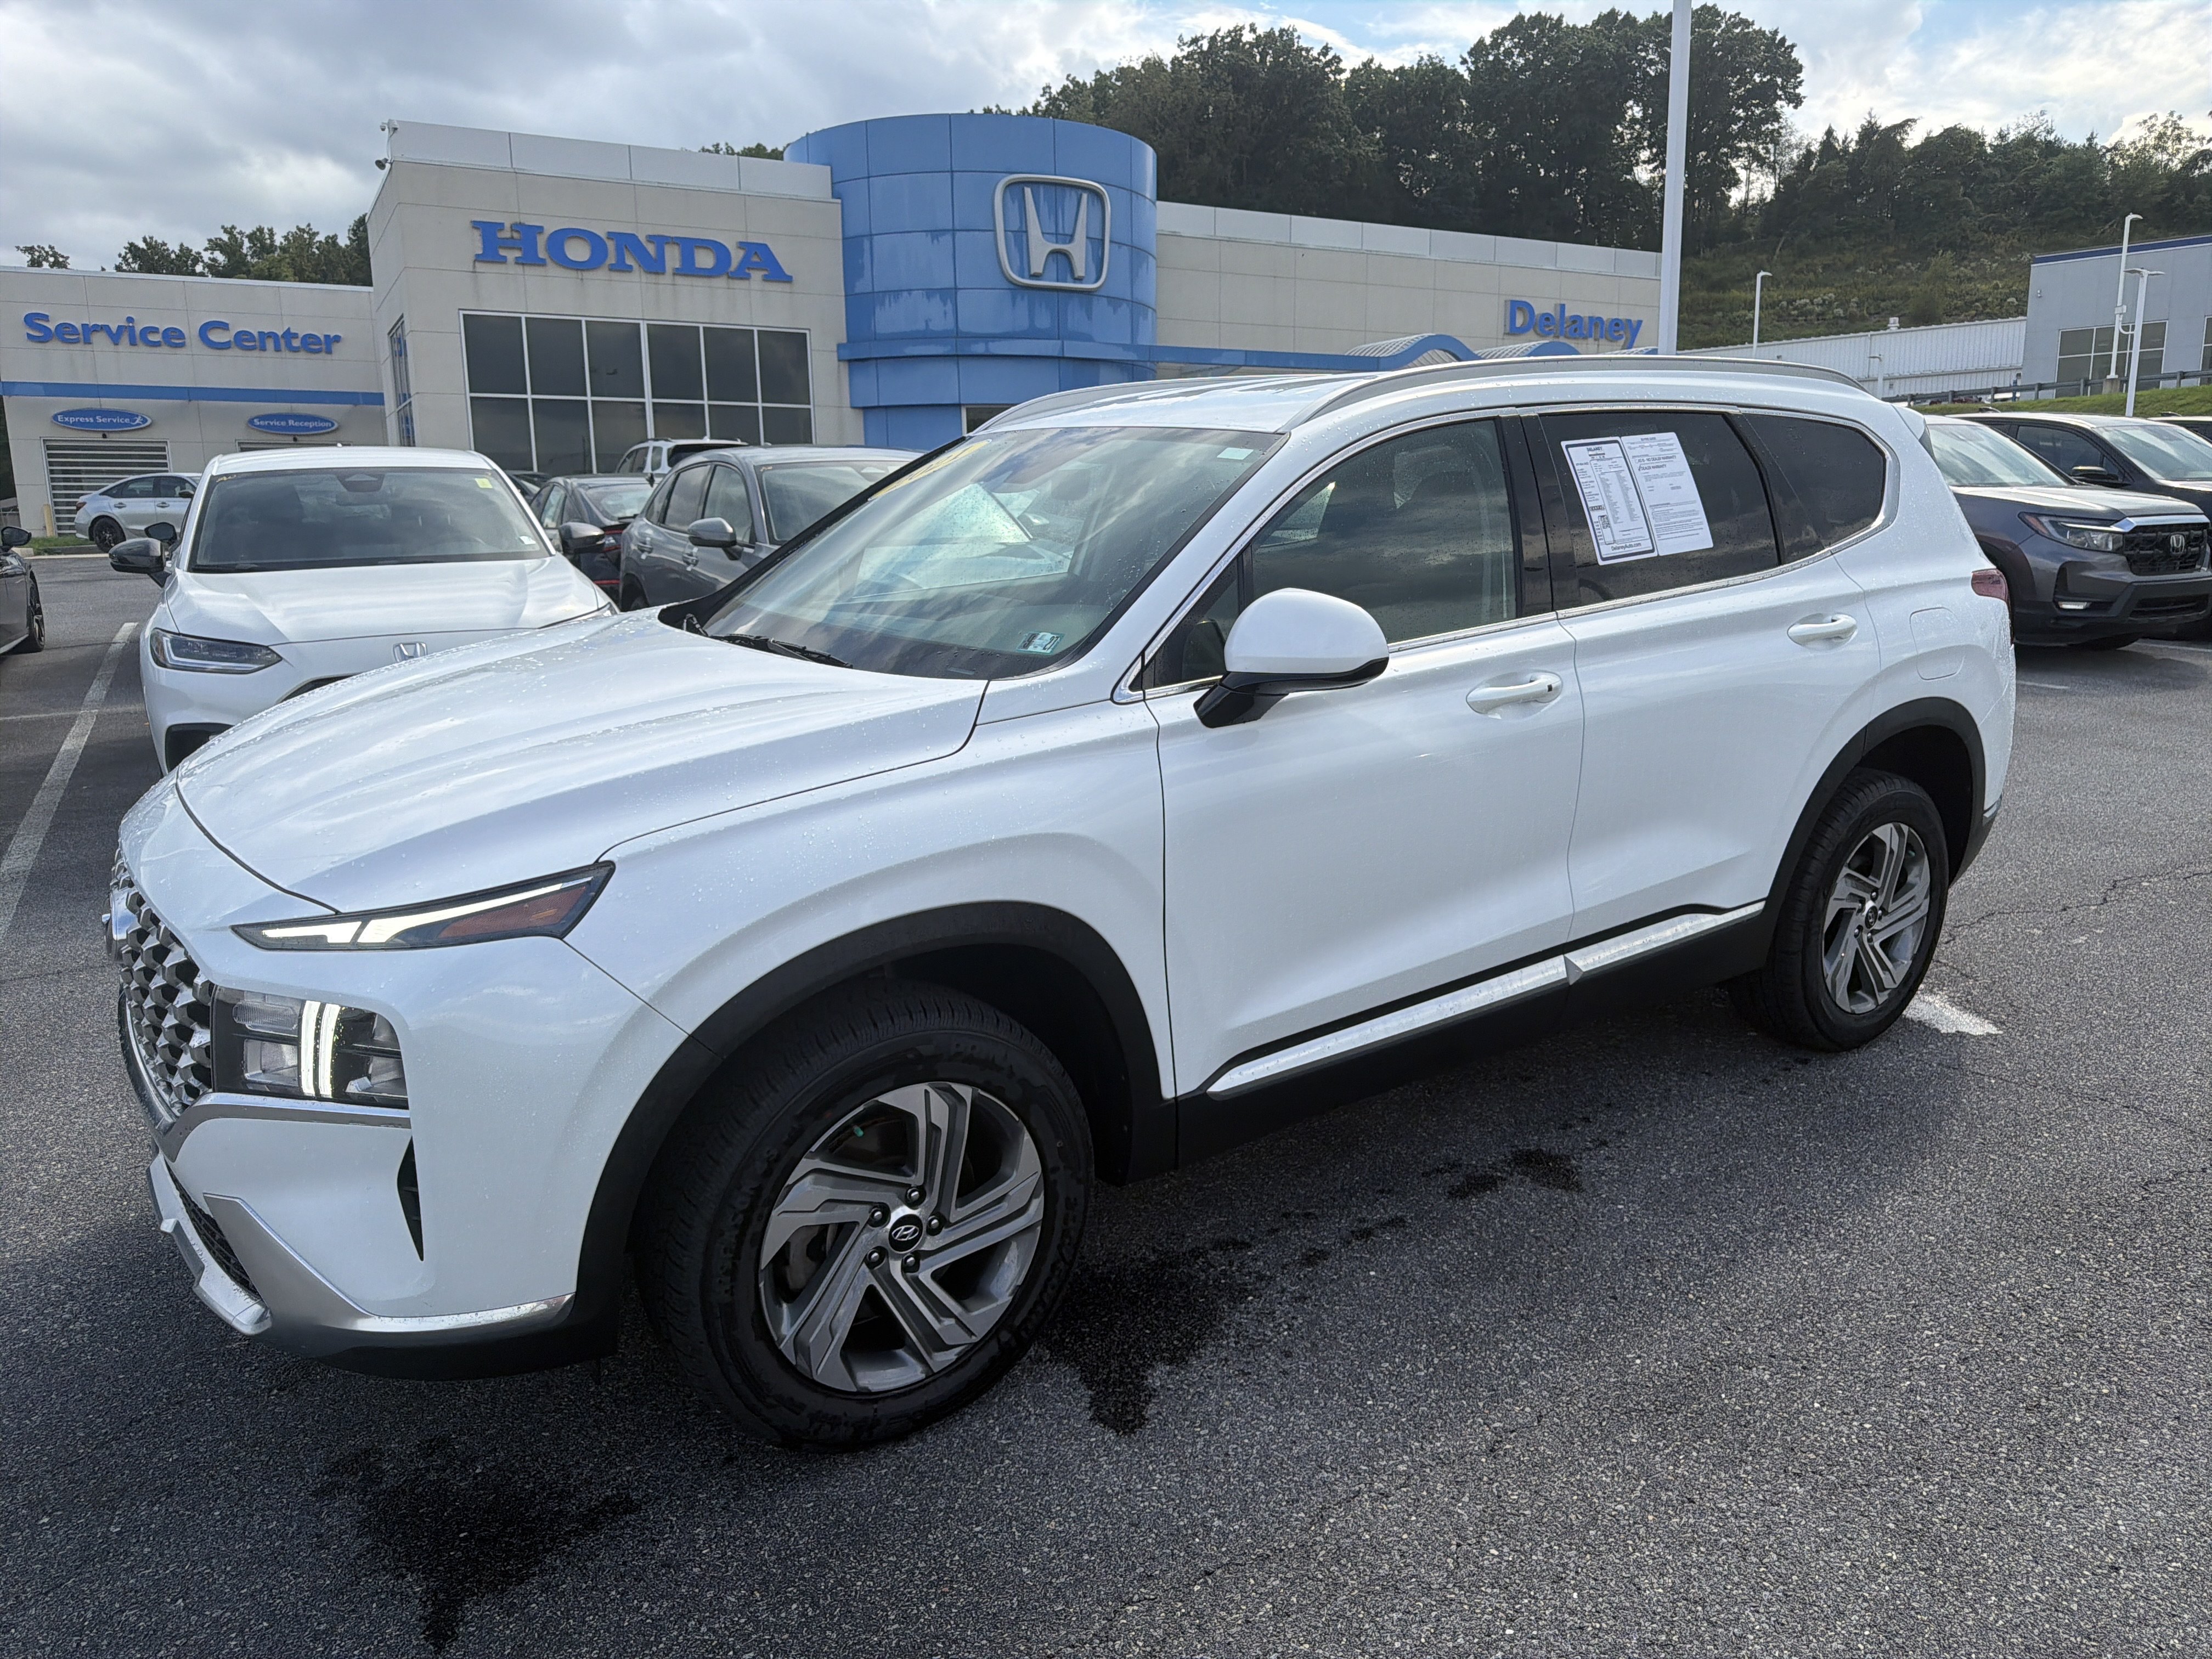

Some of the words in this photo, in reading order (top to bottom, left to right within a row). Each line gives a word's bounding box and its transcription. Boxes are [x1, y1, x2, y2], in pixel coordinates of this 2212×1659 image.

[472, 220, 793, 282] HONDA
[24, 312, 186, 348] Service
[198, 320, 342, 354] Center
[1506, 300, 1643, 349] Delaney
[57, 415, 94, 424] Express
[95, 415, 131, 424] Service
[253, 418, 287, 426] Service
[288, 419, 331, 428] Reception
